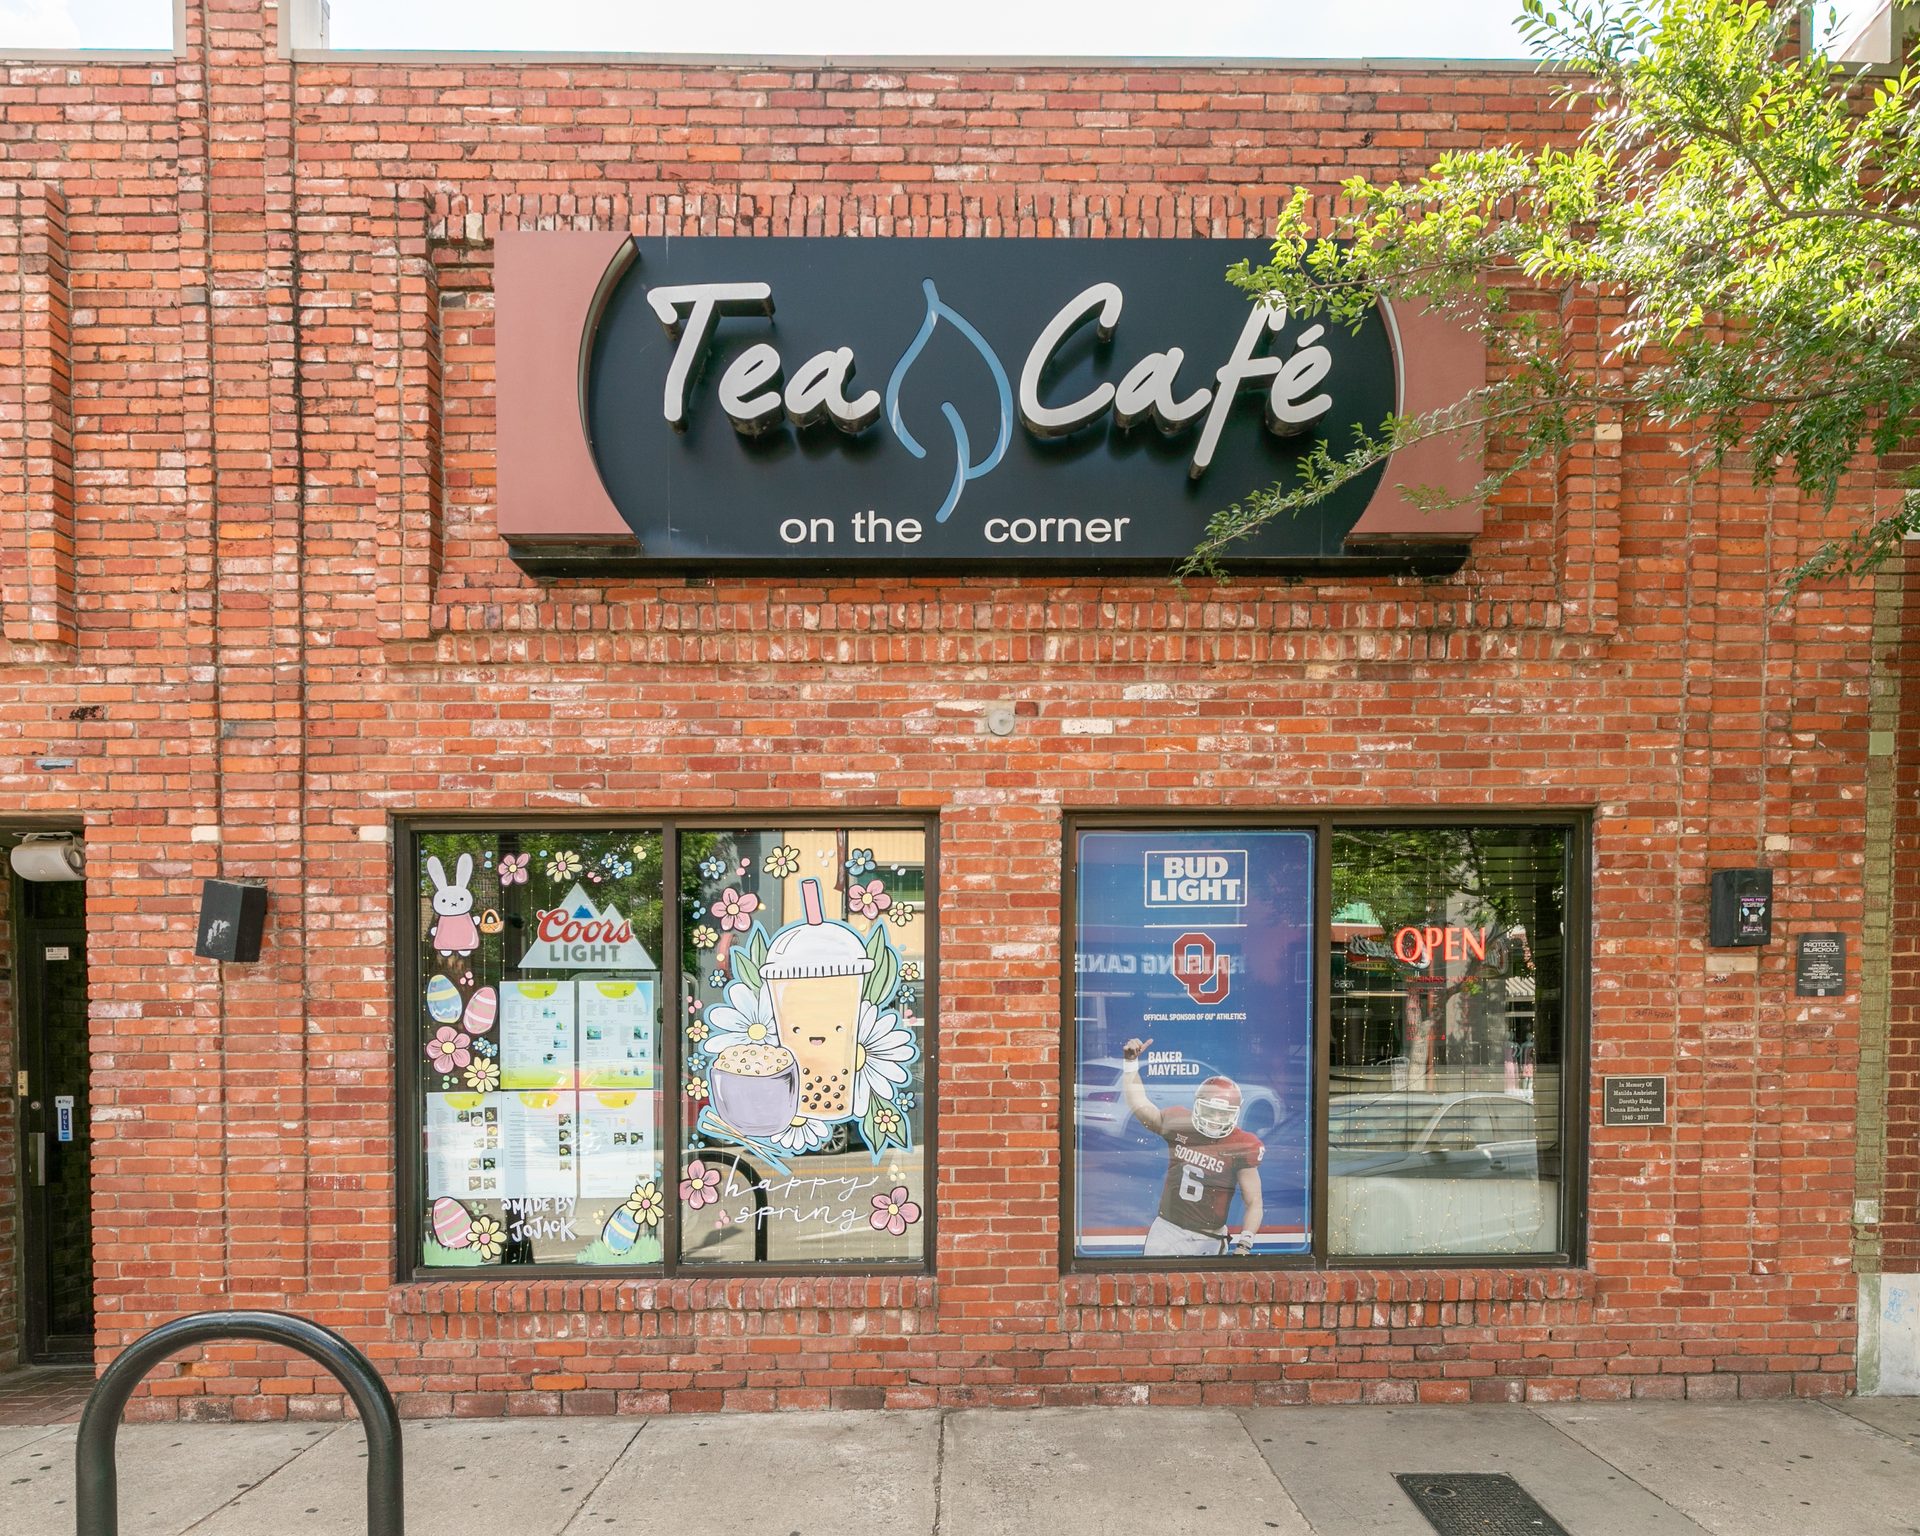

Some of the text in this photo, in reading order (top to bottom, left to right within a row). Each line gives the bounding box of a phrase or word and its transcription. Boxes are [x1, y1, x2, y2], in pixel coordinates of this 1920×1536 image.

[646, 281, 1333, 470] Tea Café
[779, 510, 1131, 543] on the corner
[1163, 856, 1229, 879] BUD
[1151, 879, 1241, 902] LIGHT
[536, 908, 635, 943] Coors
[549, 944, 621, 962] LIGHT
[1394, 926, 1486, 963] OPEN
[1143, 1013, 1169, 1021] OFFICIAL
[1169, 1013, 1196, 1021] SPONSOR
[1216, 1012, 1247, 1020] ATHLETICS
[1148, 1051, 1183, 1063] BAKER
[1148, 1064, 1200, 1076] MAYFIELD
[1174, 1144, 1225, 1173] SOONERS
[724, 1154, 880, 1202] happy
[1179, 1163, 1205, 1203] 6
[555, 1196, 577, 1217] BY
[734, 1205, 869, 1232] spring
